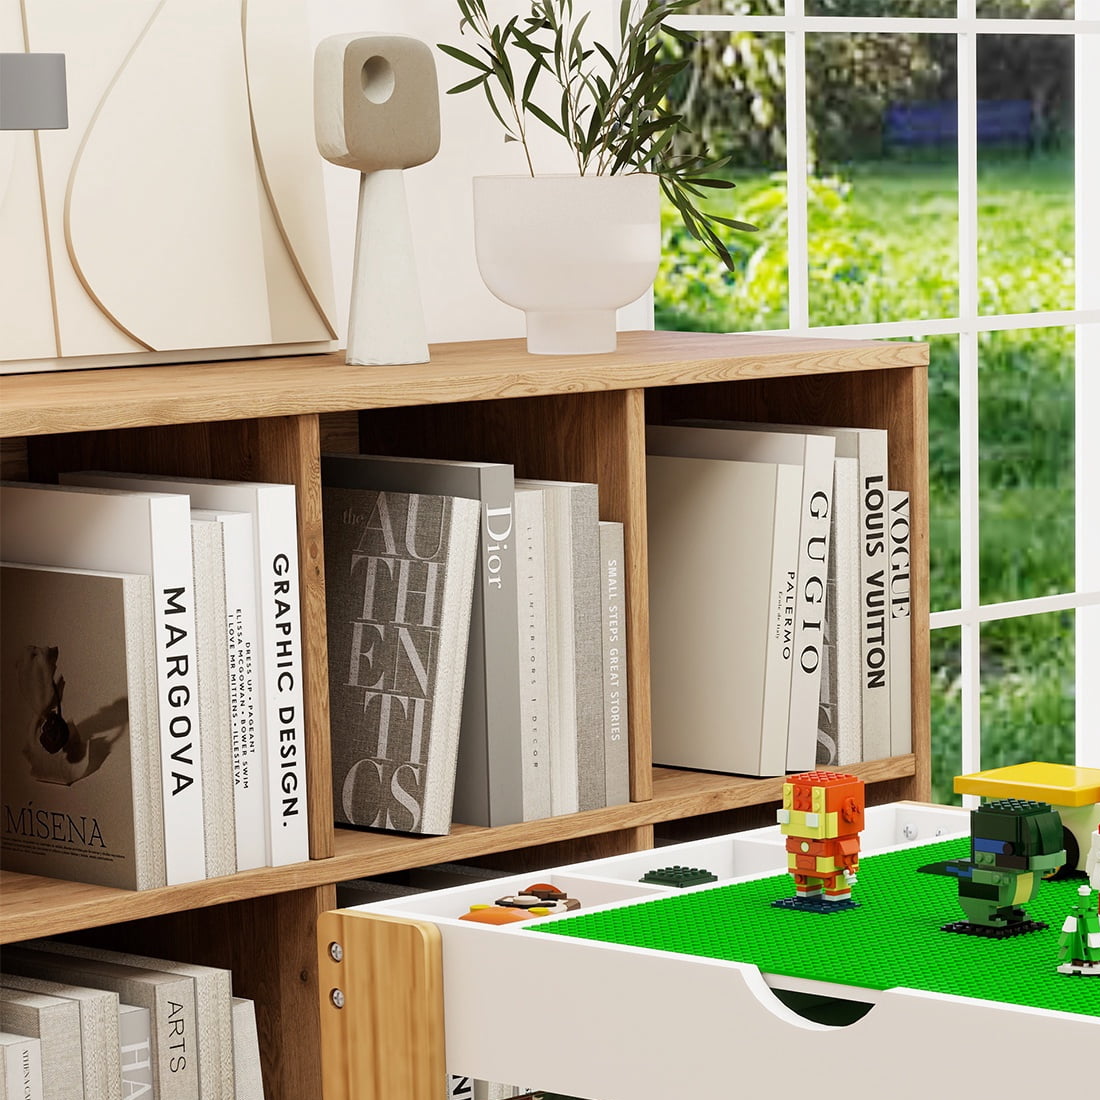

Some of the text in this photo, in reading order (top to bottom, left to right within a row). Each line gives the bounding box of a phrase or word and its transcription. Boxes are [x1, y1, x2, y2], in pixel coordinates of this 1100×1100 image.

[341, 507, 364, 525] the
[486, 502, 512, 589] Dior
[890, 496, 910, 619] VOGUE
[783, 571, 795, 660] PALERMO
[800, 491, 829, 674] GUGIO
[864, 475, 886, 689] LOUIS VUITTON
[163, 586, 194, 796] MARGOVA
[230, 654, 236, 669] MR
[247, 679, 252, 692] UP
[272, 553, 299, 828] GRAPHIC DESIGN.
[608, 559, 620, 741] SMALL STEPS GREAT STORIES
[167, 1000, 187, 1073] ARTS
